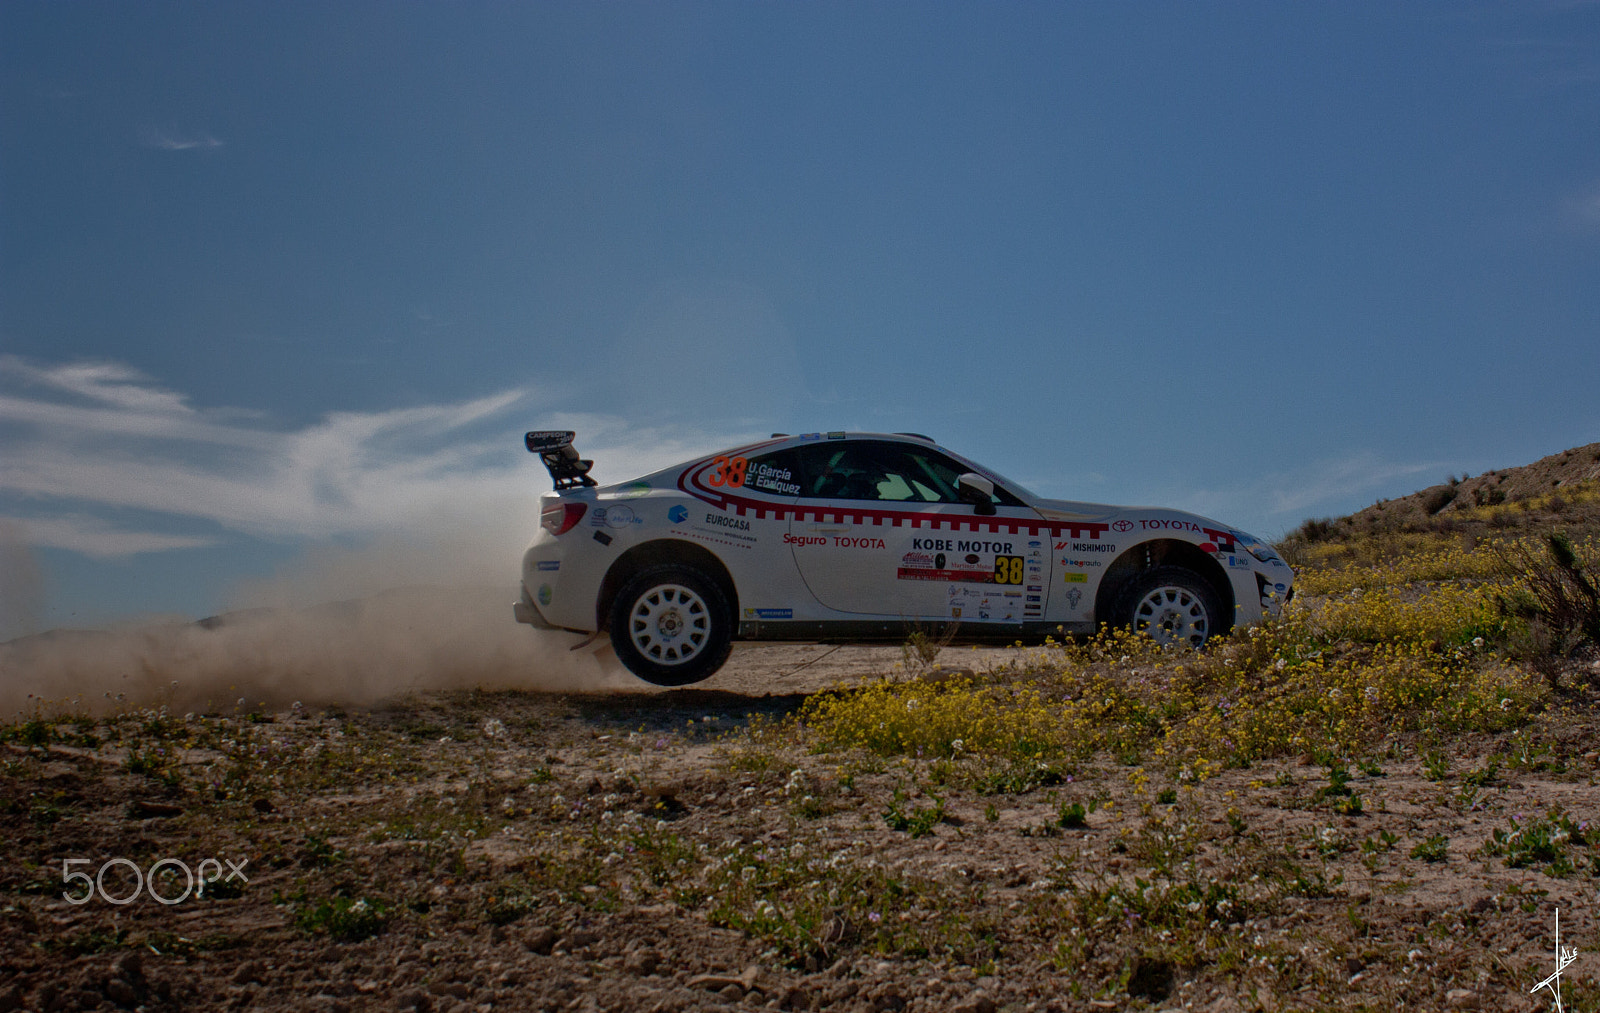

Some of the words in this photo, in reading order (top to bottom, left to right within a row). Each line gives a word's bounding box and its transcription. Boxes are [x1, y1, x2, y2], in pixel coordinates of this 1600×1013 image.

[709, 455, 748, 488] 38
[744, 473, 754, 485] E.
[748, 461, 792, 481] U.García
[705, 513, 750, 532] EUROCASA
[1139, 519, 1202, 533] TOYOTA
[783, 533, 827, 547] Seguro
[833, 536, 886, 550] TOYOTA
[913, 538, 953, 552] KOBE
[957, 540, 1013, 554] MOTOR
[1072, 543, 1116, 553] MISHIMOTO
[994, 556, 1024, 585] 38
